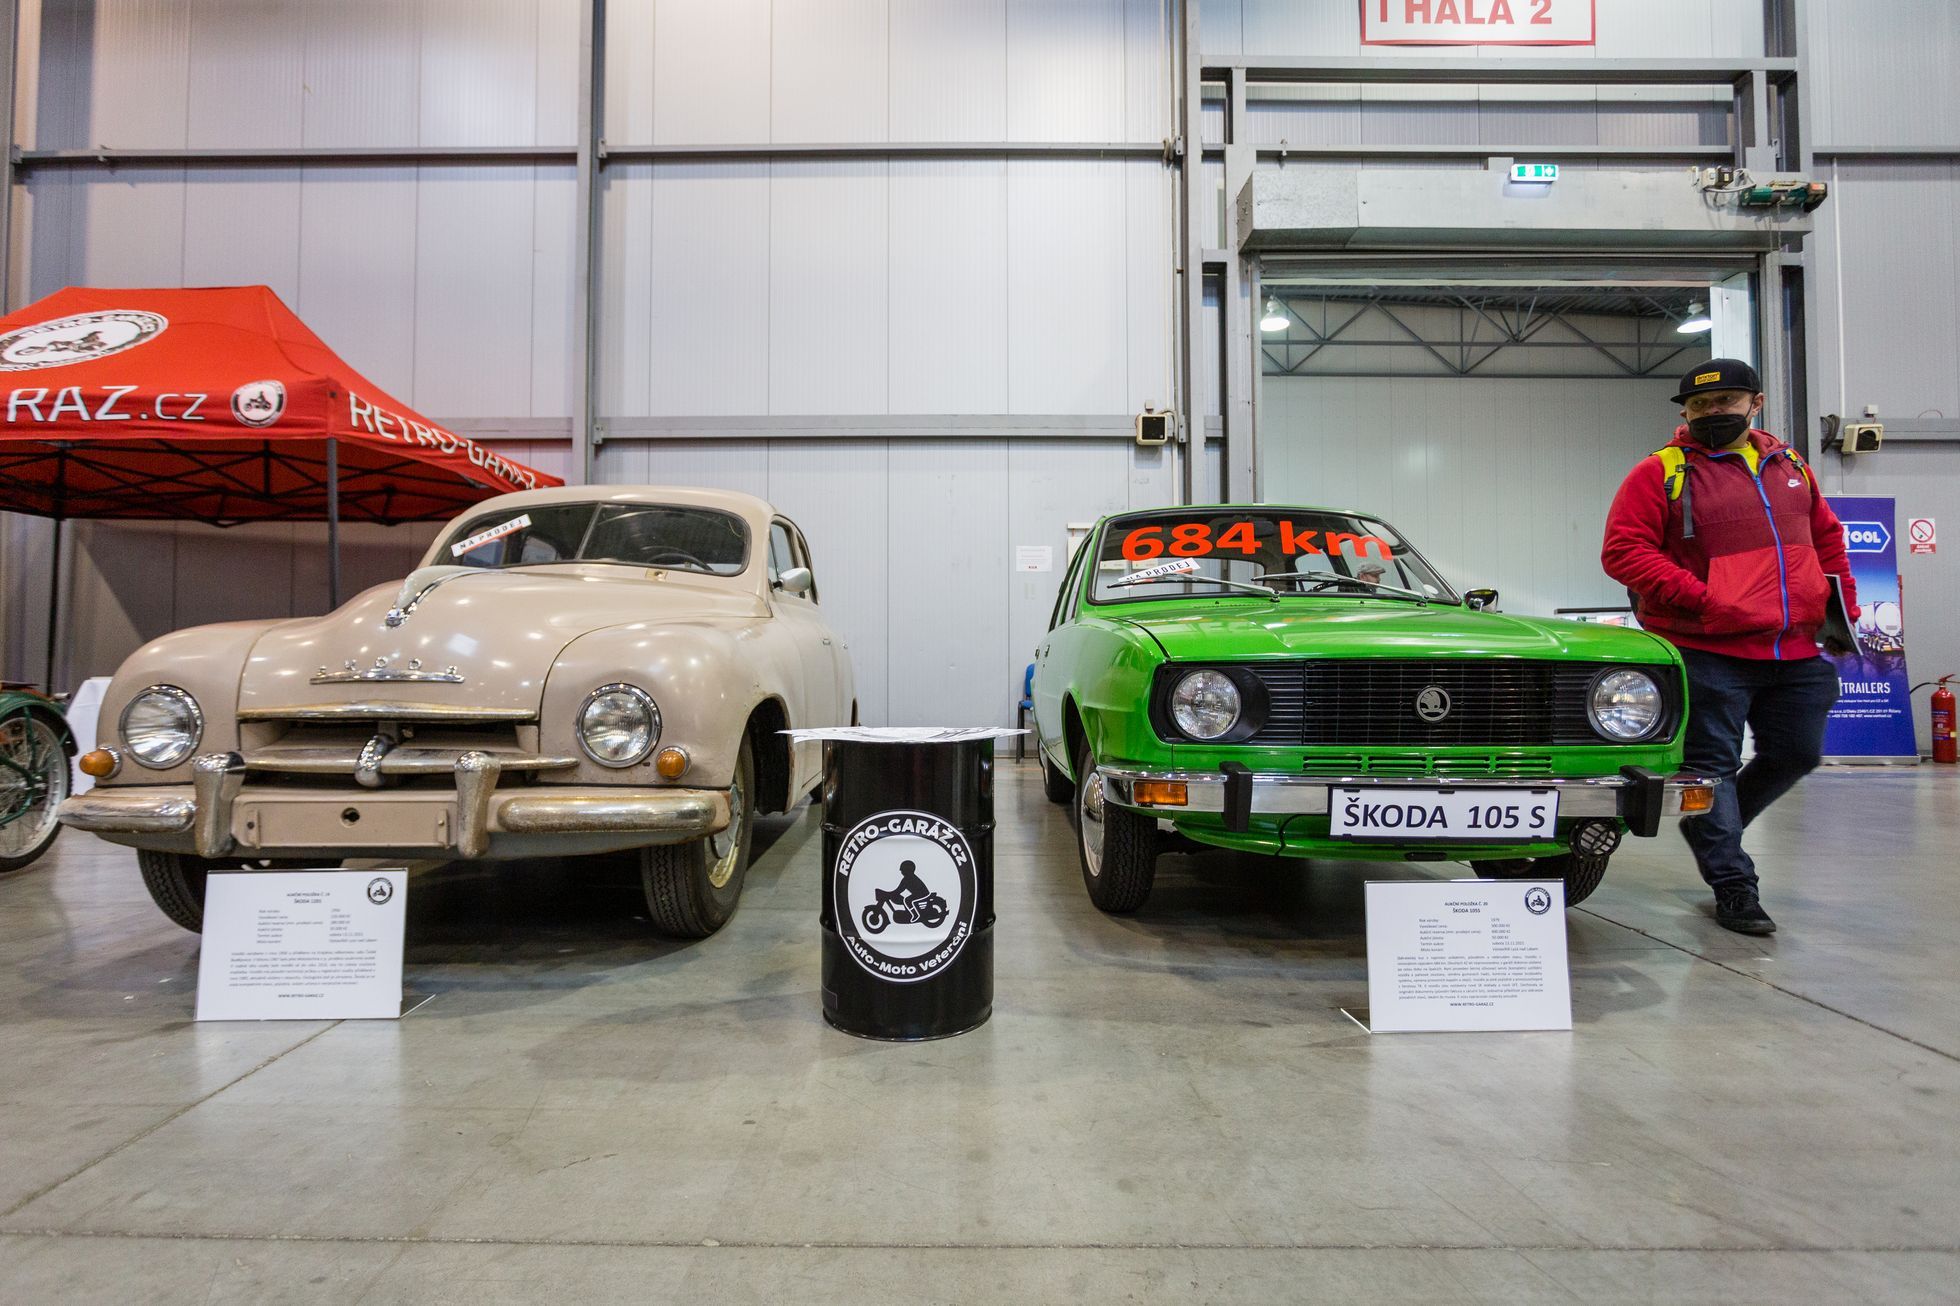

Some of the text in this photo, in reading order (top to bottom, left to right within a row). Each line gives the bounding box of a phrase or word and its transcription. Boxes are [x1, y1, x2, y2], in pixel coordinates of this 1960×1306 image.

[1404, 0, 1553, 24] HALA 2
[478, 519, 522, 541] PRODEJ
[1121, 520, 1394, 562] 684 km
[1145, 561, 1190, 577] PRODEJ
[1843, 682, 1891, 694] TRAILERS
[1343, 796, 1546, 829] ŠKODA 105 S
[838, 818, 968, 877] RETRO-GARÁŽ.CZ
[846, 935, 917, 975] Auto-Moto
